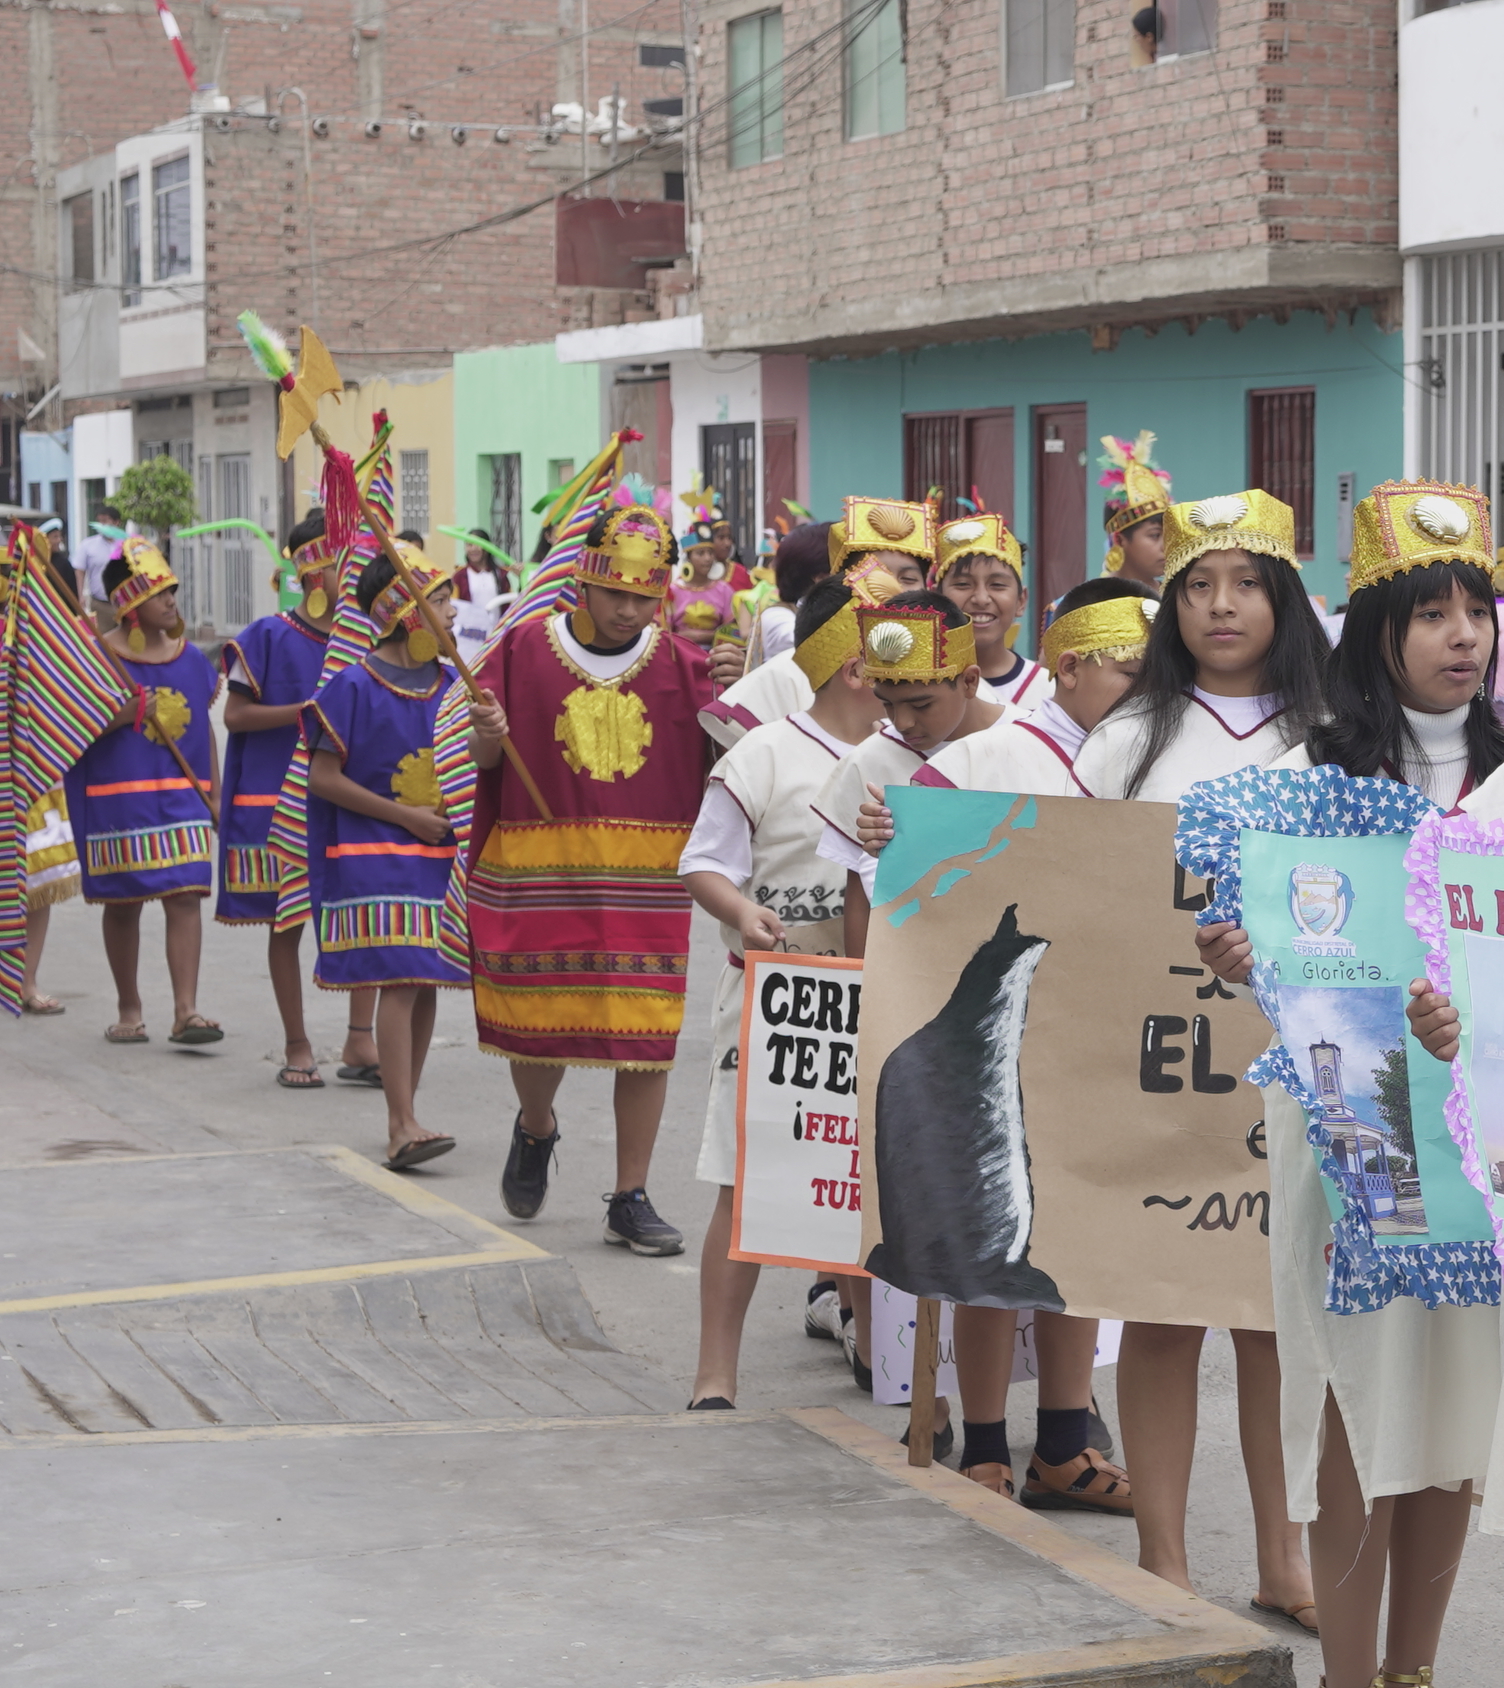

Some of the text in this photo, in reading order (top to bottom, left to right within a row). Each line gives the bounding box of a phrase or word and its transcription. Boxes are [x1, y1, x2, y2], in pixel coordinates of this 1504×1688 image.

[1444, 883, 1483, 932] EL
[1293, 944, 1356, 958] CERRO AZUL
[766, 1032, 858, 1095] TE E
[1140, 1014, 1238, 1094] EL
